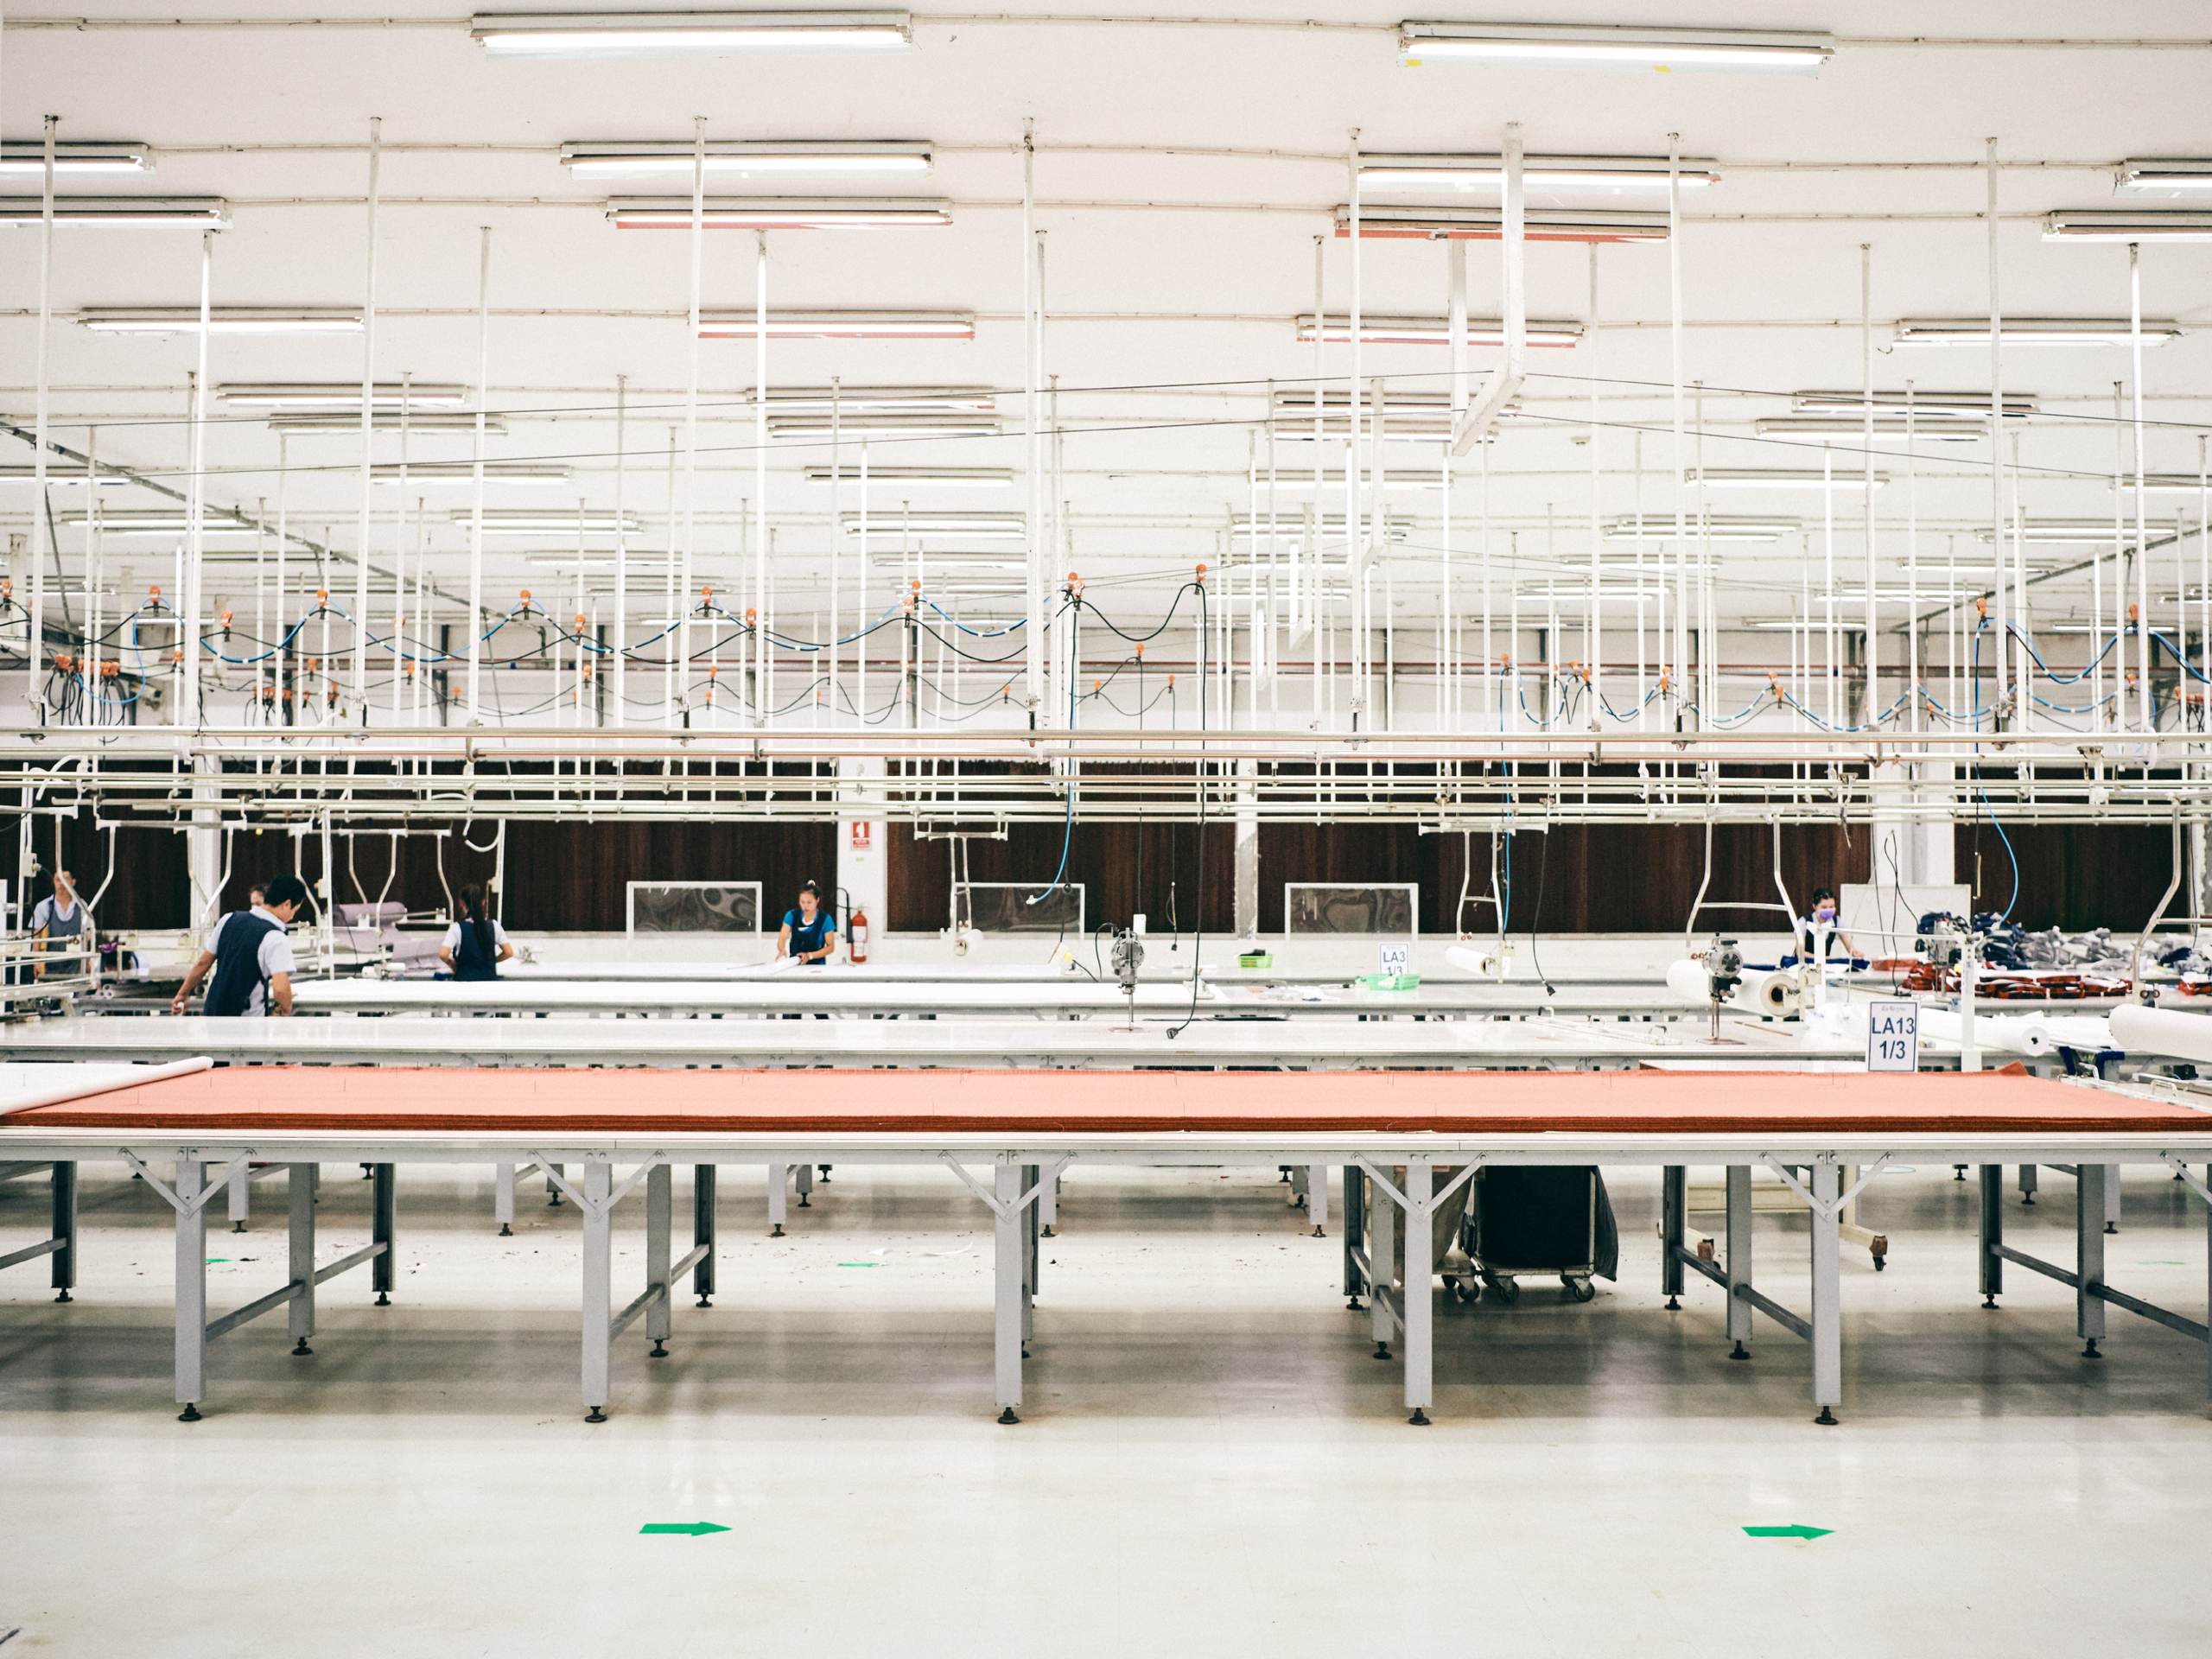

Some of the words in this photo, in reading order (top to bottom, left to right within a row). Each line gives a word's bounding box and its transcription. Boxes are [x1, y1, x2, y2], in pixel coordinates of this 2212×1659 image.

[1383, 951, 1406, 963] LA3
[1872, 1017, 1915, 1034] LA13
[1879, 1040, 1906, 1059] 1/3
